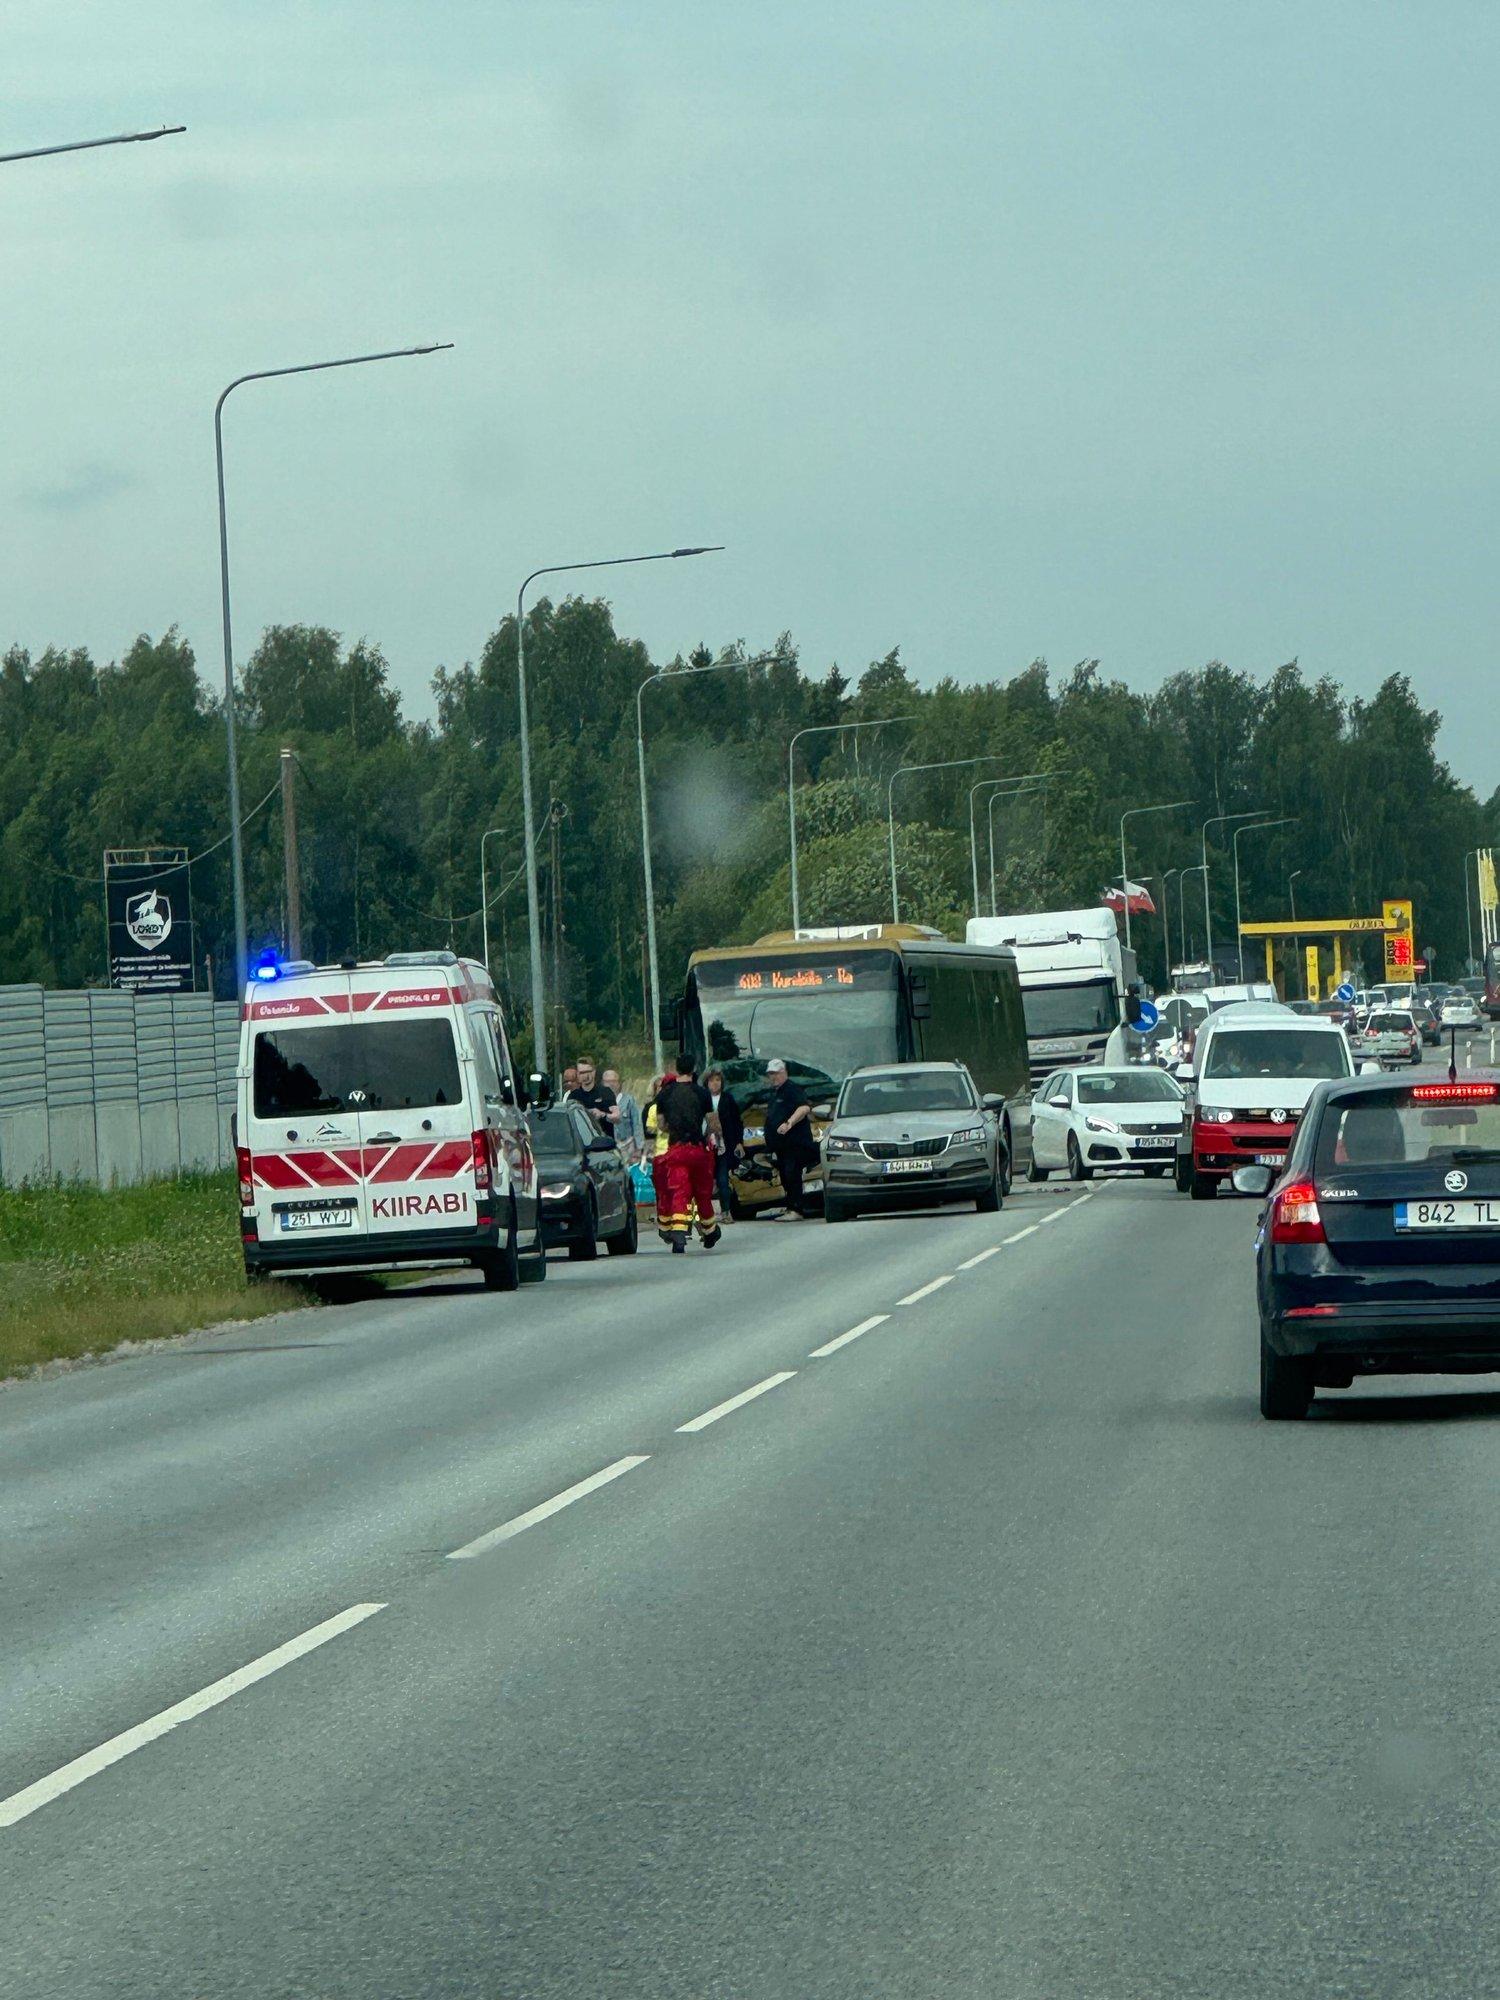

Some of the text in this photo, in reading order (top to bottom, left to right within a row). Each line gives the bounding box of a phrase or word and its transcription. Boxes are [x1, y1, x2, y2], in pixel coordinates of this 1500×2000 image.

[372, 1192, 467, 1218] KIIRABI
[1418, 1203, 1499, 1224] 842 TL
[291, 1210, 348, 1226] 251 WYJ
